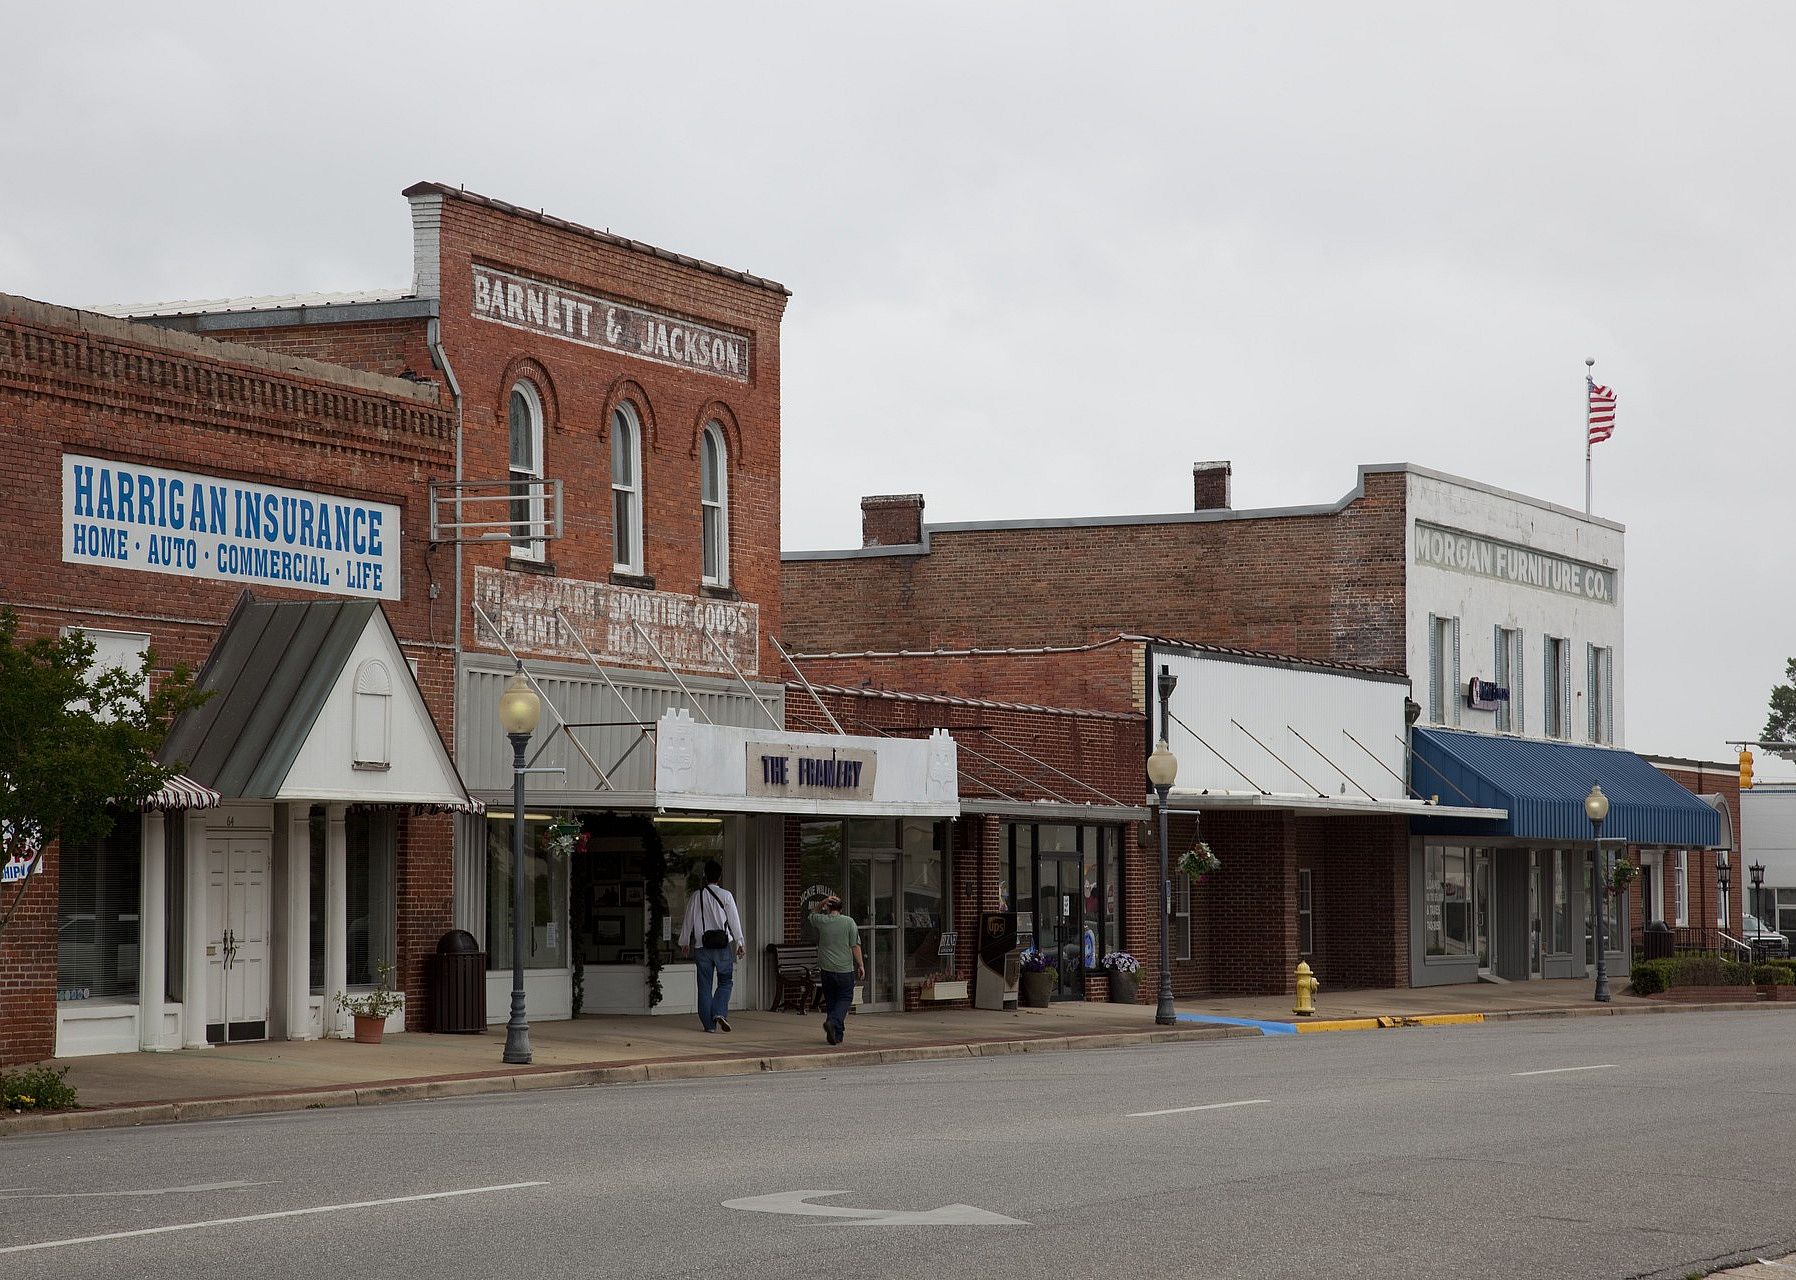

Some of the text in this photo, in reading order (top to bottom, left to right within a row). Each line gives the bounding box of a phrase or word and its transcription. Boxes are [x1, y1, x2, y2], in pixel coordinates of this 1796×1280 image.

[474, 275, 739, 373] BARNETT & JACKSON
[73, 464, 383, 556] HARRIGAN INSURANCE
[73, 524, 383, 592] HOME AUTO COMMERCIAL LIFE
[1415, 526, 1492, 574] MORGAN
[1497, 548, 1581, 595] FURNITURE
[501, 610, 569, 646] PAINTS
[609, 593, 688, 627] SPORTING
[694, 604, 748, 635] GOODS
[761, 756, 863, 788] THE FRAMERY
